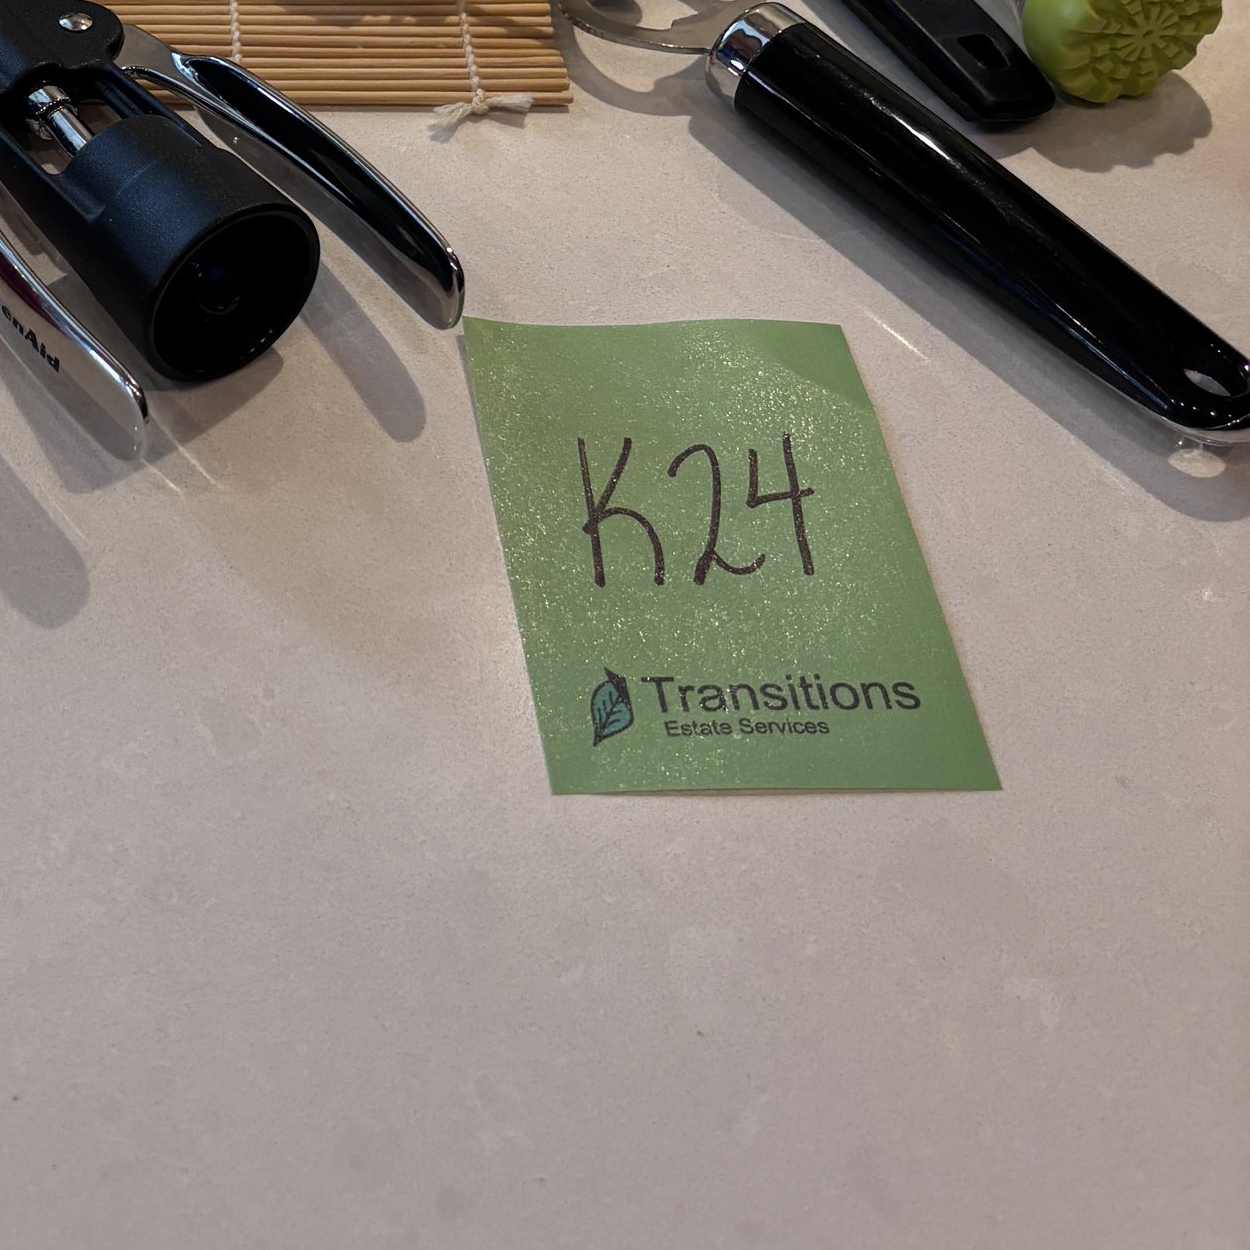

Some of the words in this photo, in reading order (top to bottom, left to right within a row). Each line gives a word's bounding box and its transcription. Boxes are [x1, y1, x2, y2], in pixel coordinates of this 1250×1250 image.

[577, 431, 815, 588] K24
[640, 673, 921, 716] Transitions
[664, 719, 733, 737] Estate
[739, 717, 830, 735] Services
